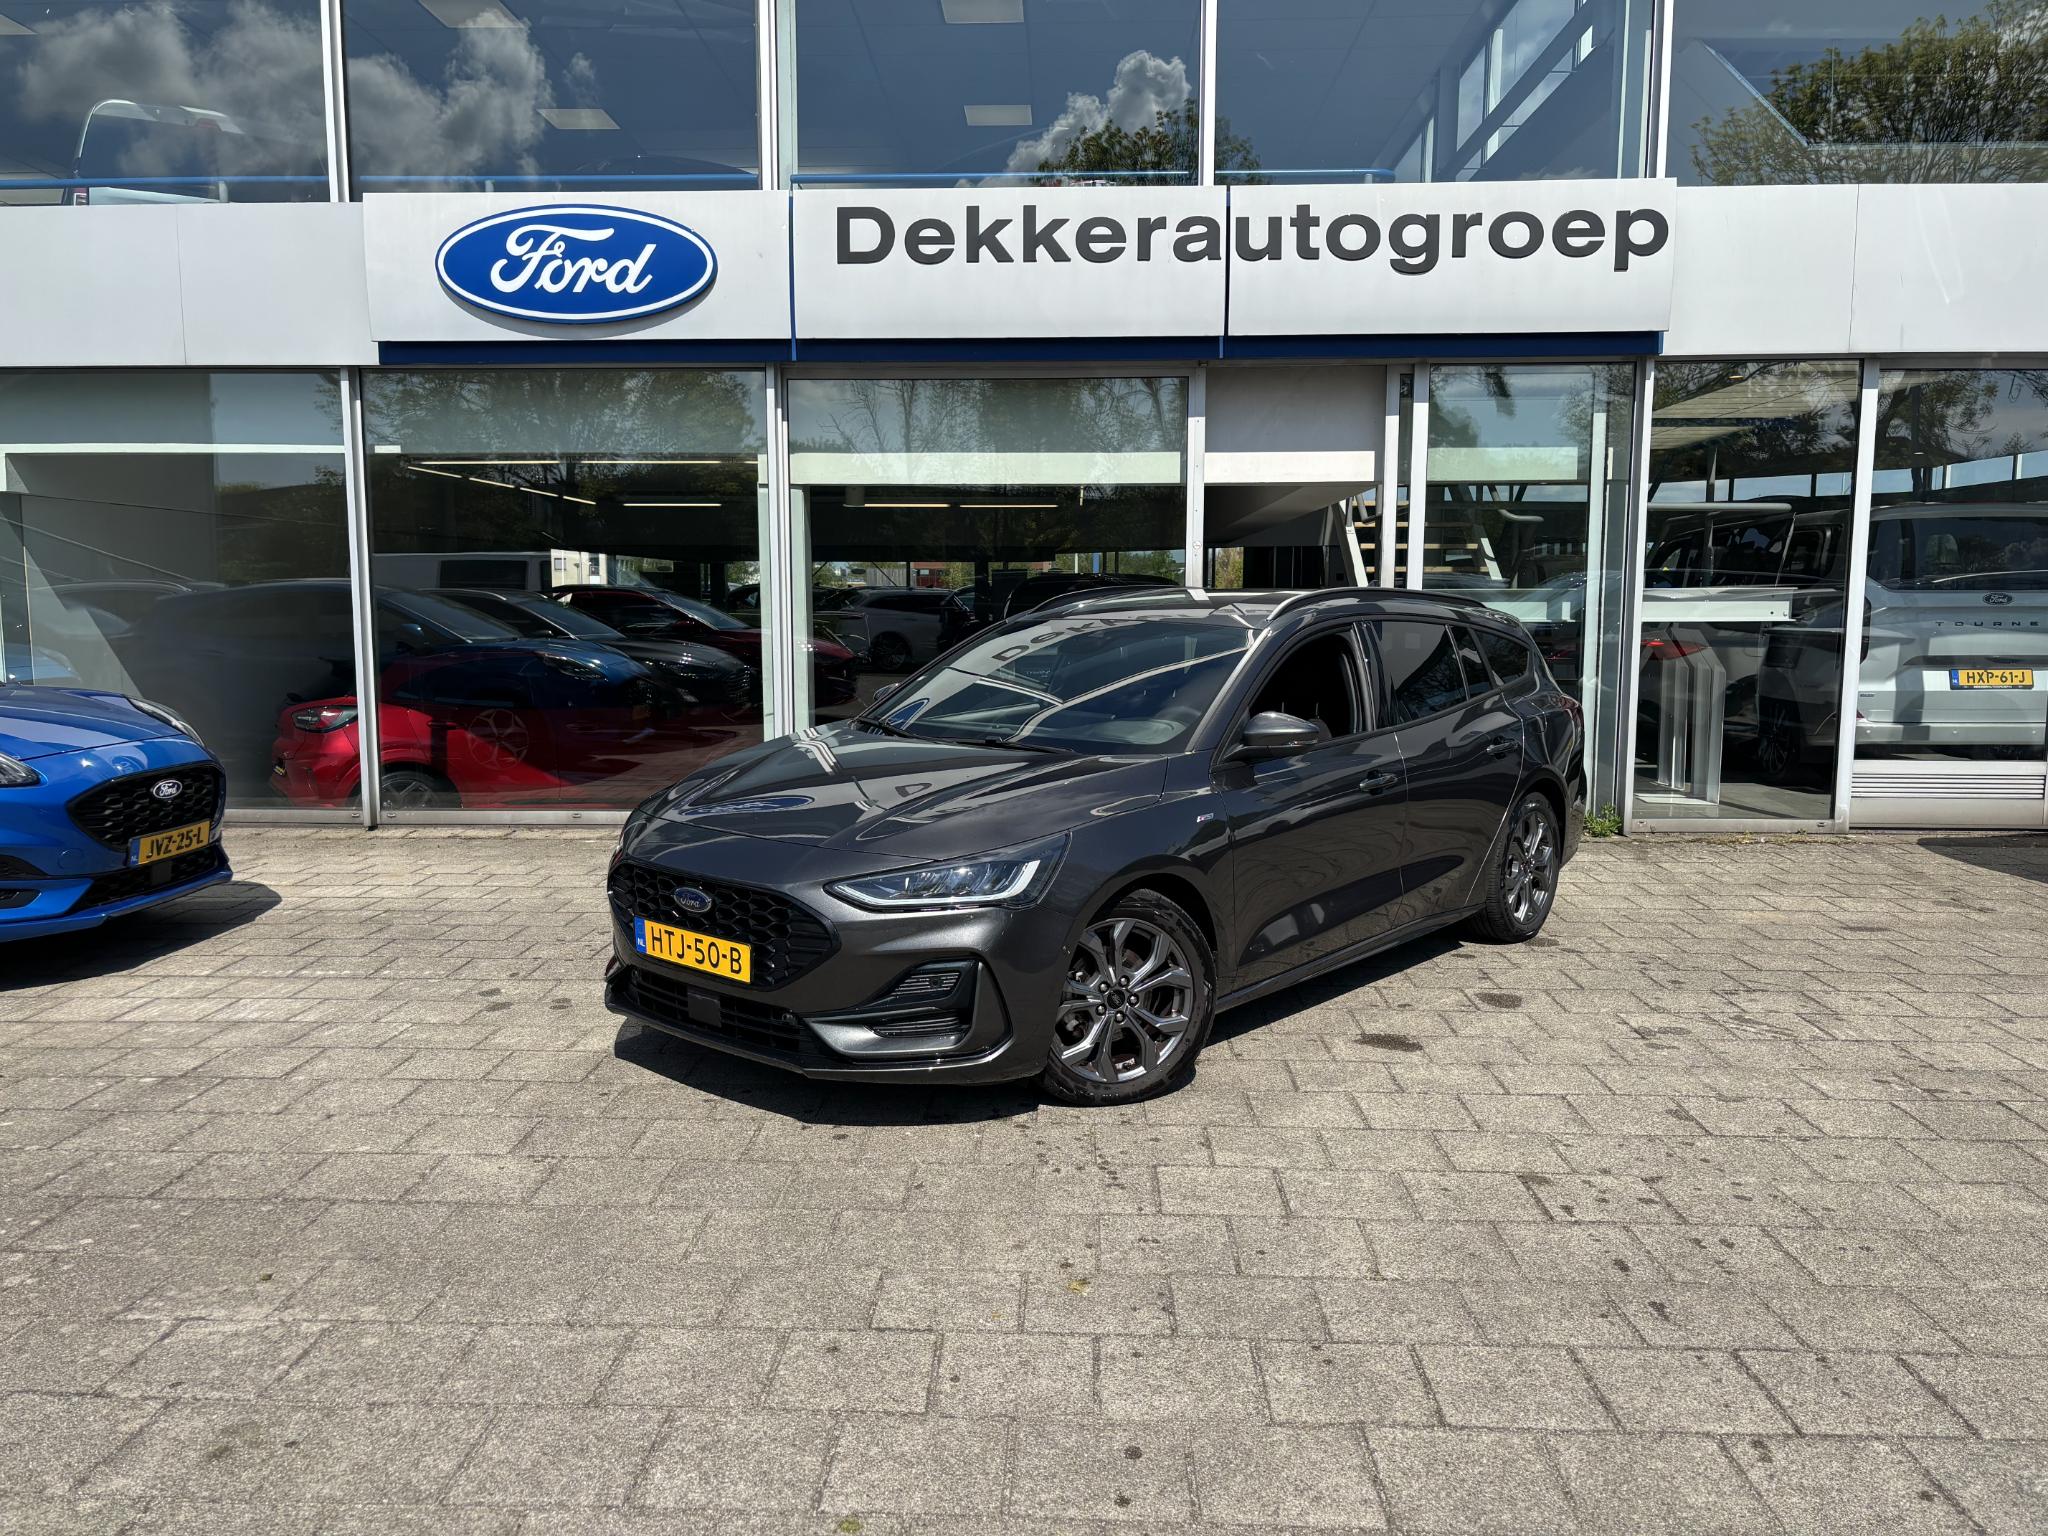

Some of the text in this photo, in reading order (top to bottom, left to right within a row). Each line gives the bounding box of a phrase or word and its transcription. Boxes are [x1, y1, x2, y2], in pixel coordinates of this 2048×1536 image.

[490, 224, 656, 293] Ford
[836, 204, 1669, 274] Dekkerautogroep
[1966, 671, 2025, 683] HXP-61-J
[159, 783, 177, 796] Ford
[146, 827, 203, 858] JVZ-25-L
[651, 926, 742, 974] HTJ-50-B
